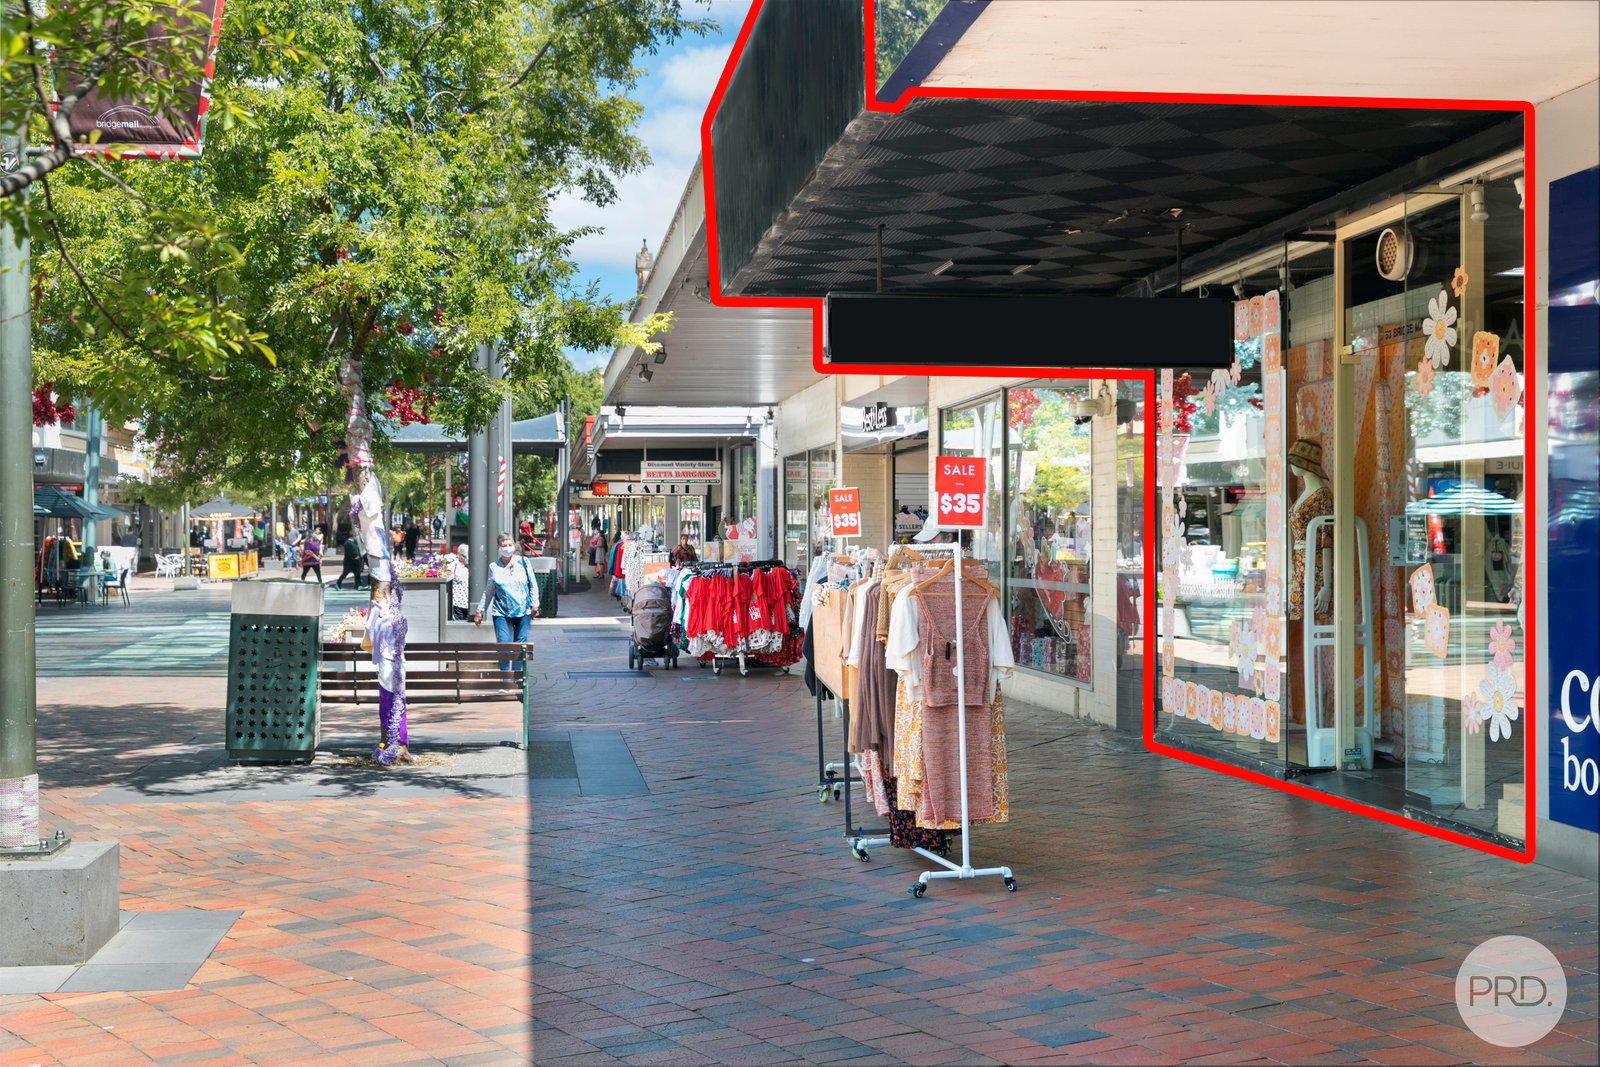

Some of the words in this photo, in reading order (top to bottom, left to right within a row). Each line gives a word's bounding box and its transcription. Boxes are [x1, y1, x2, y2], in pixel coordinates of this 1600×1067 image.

[96, 120, 139, 129] bridgemall
[944, 464, 975, 476] SALE
[627, 484, 690, 494] CAPRI
[834, 494, 853, 502] SALE
[940, 492, 981, 515] $35
[834, 513, 857, 528] $35
